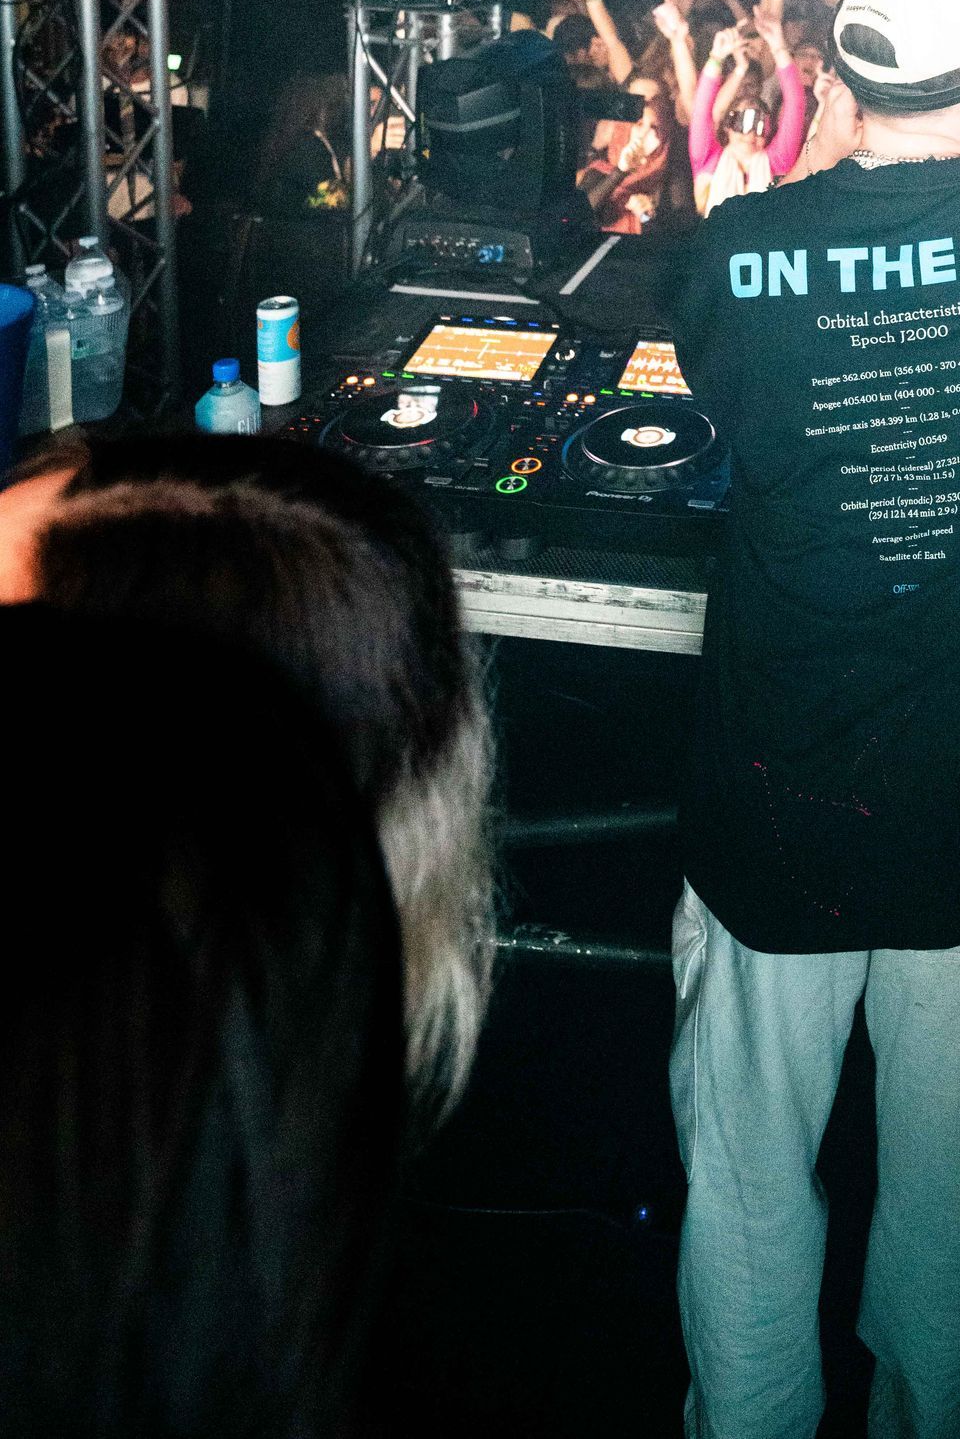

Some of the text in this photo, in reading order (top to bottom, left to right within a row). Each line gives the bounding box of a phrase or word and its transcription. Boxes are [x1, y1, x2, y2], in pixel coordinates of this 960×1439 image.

[730, 250, 808, 298] ON
[827, 237, 956, 292] THE
[816, 311, 869, 330] Orbital
[849, 324, 949, 349] Epoch J2000
[811, 376, 841, 387] Perigee
[842, 370, 878, 383] 362.600
[879, 369, 892, 378] km
[893, 365, 914, 377] (356
[914, 362, 933, 374] 400
[939, 360, 957, 371] 370
[812, 401, 842, 412] Apogee
[842, 393, 879, 407] 405.400
[879, 392, 893, 402] km
[893, 389, 915, 401] (404
[915, 386, 935, 398] 000
[805, 423, 851, 437] Semi-major
[852, 420, 869, 431] axis
[869, 415, 904, 428] 384.399
[904, 414, 918, 424] km
[870, 433, 948, 454] Eccentricity 0.0549
[840, 464, 869, 475] Orbital
[870, 465, 896, 474] period
[897, 460, 935, 473] (sidereal)
[869, 473, 883, 485] (27
[890, 473, 896, 482] 7
[903, 473, 915, 481] 43
[915, 473, 931, 481] min
[933, 471, 947, 481] 11.5
[840, 499, 869, 512] Orbital
[870, 496, 896, 510] period
[896, 494, 934, 508] (synodic)
[868, 510, 883, 522] (29
[890, 509, 900, 519] 12
[907, 508, 919, 518] 44
[920, 509, 936, 518] min
[938, 507, 949, 516] 2.9
[872, 524, 954, 544] Average orbital speed
[879, 553, 911, 562] Satellite
[924, 549, 946, 560] Earth
